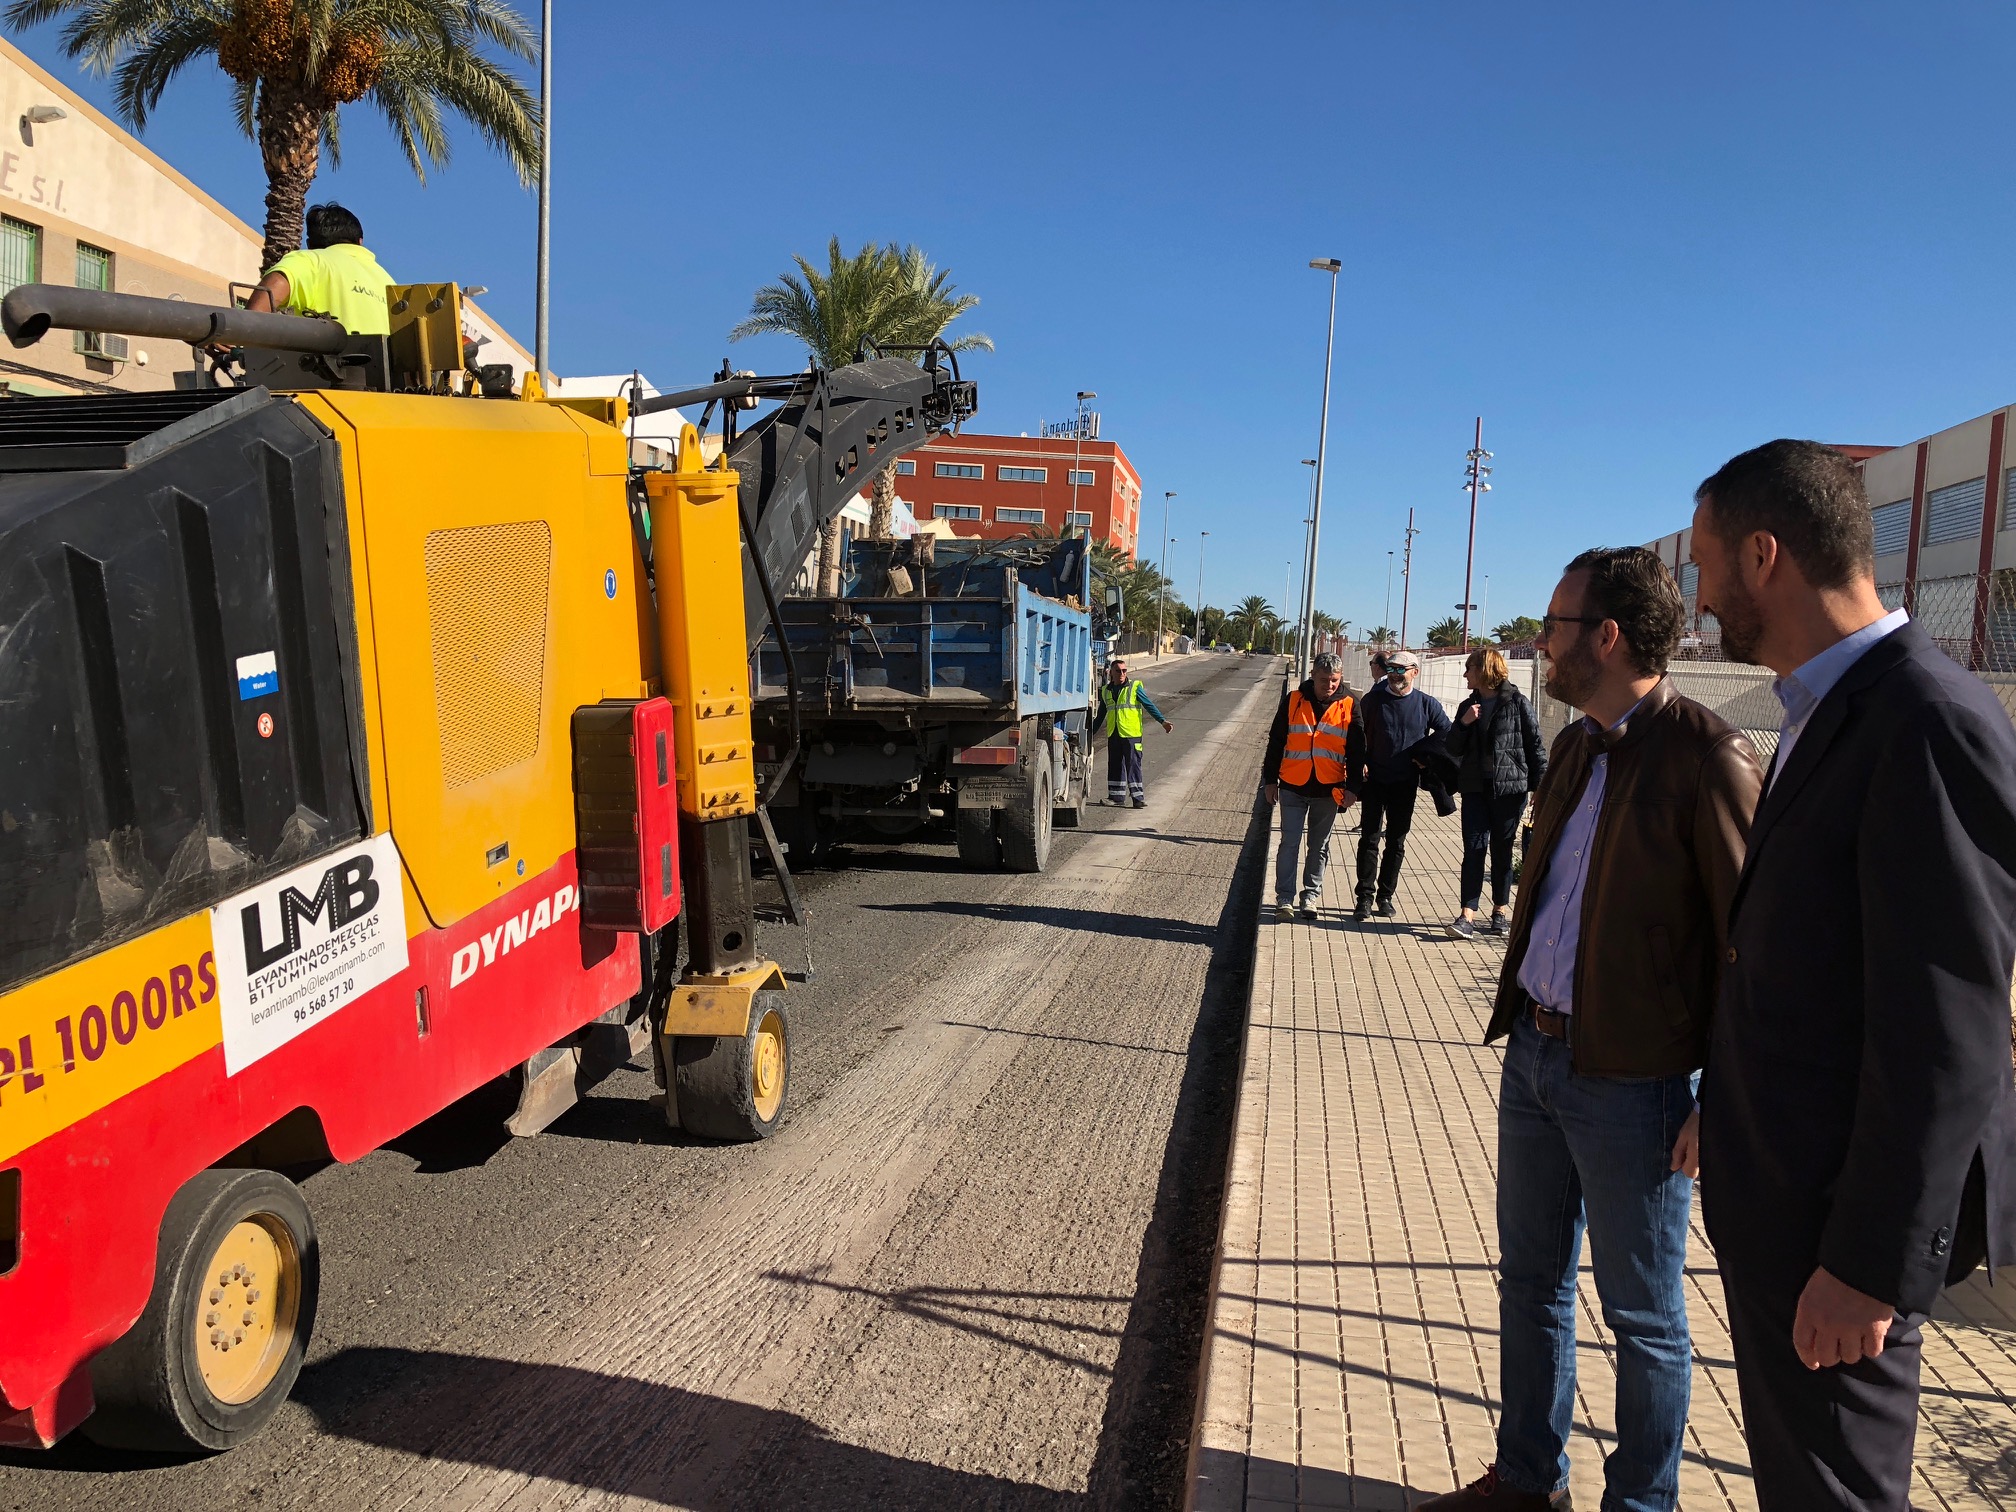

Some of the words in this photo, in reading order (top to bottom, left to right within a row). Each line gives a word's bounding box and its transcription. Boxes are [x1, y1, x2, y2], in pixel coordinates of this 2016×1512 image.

[252, 681, 267, 690] Water
[240, 853, 380, 977] LMB
[247, 913, 380, 993] LEVANTINADEMEZCLAS
[249, 938, 357, 1006] BITUMINOSAS
[360, 928, 381, 943] S.L.
[251, 941, 386, 1026] levantinamb@levantinamb.com
[293, 1008, 307, 1024] 96
[309, 997, 327, 1015] 568
[329, 985, 340, 1002] 57
[343, 977, 354, 995] 30
[55, 950, 216, 1074] 1000RS
